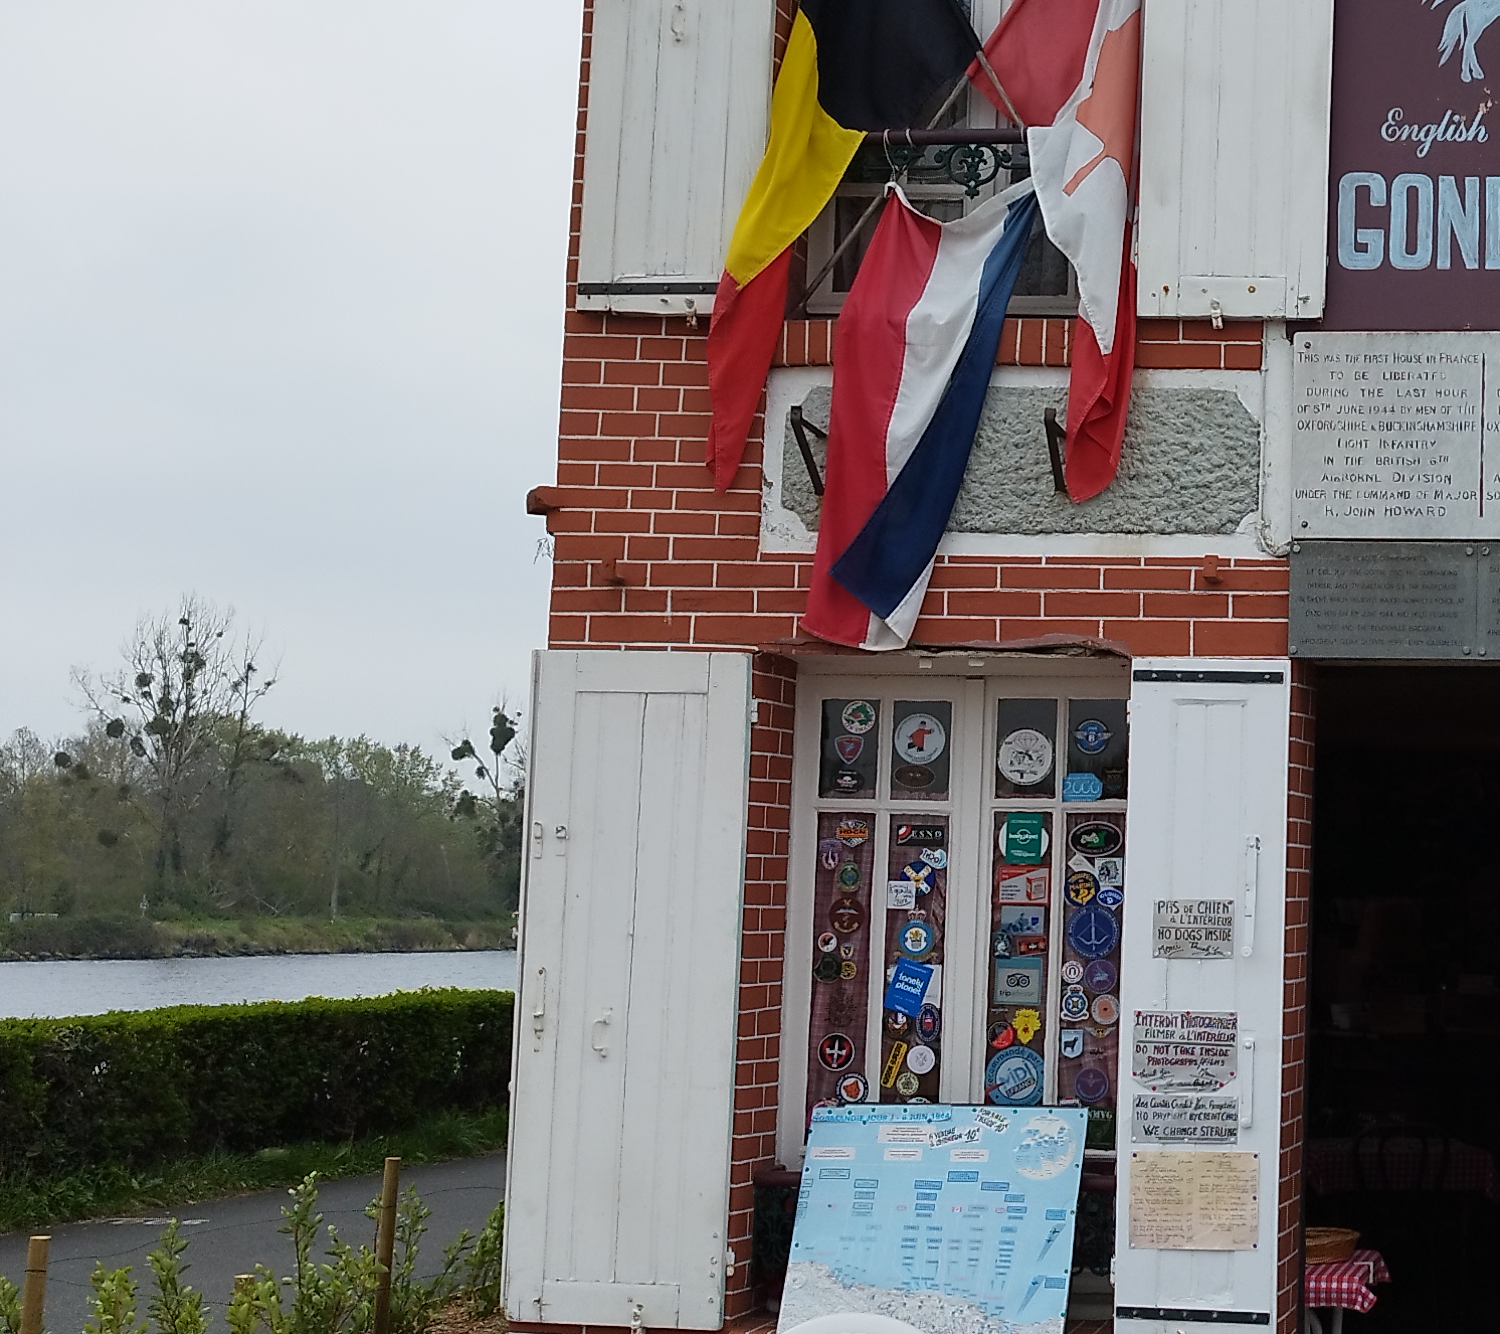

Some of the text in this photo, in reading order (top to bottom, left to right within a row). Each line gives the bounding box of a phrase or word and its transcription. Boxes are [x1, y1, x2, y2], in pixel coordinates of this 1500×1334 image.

[1380, 108, 1488, 157] English
[1364, 354, 1389, 363] FIRST
[1393, 352, 1422, 364] HOUSE
[1439, 353, 1479, 364] FRANCE
[1330, 371, 1344, 380] TO
[1355, 371, 1369, 380] BE
[1307, 388, 1468, 398] DURING THE LAST HOUR
[1337, 405, 1364, 415] JUNE
[1369, 405, 1395, 414] 1944
[1416, 406, 1436, 414] MEN
[1337, 437, 1436, 449] LIGHT INFANTRY
[1324, 456, 1334, 466] IN
[1376, 456, 1421, 466] BRITISH
[1393, 472, 1451, 484] DIVISION
[1295, 490, 1326, 499] UNDER
[1333, 490, 1352, 499] THE
[1357, 490, 1410, 500] COMMAND
[1434, 490, 1477, 500] MAJOR
[1344, 506, 1446, 517] JOHN HOWARD
[1157, 901, 1180, 914] PAS
[1197, 901, 1229, 914] CHIEN
[1158, 928, 1232, 942] NO DOGS INSIDE
[899, 971, 924, 989] lonely
[895, 981, 921, 996] planet
[1145, 1029, 1176, 1038] FILMER
[1135, 1045, 1230, 1057] DO NOT TAKE INSIDE
[1143, 1125, 1237, 1137] WE CHANGE STERLING
